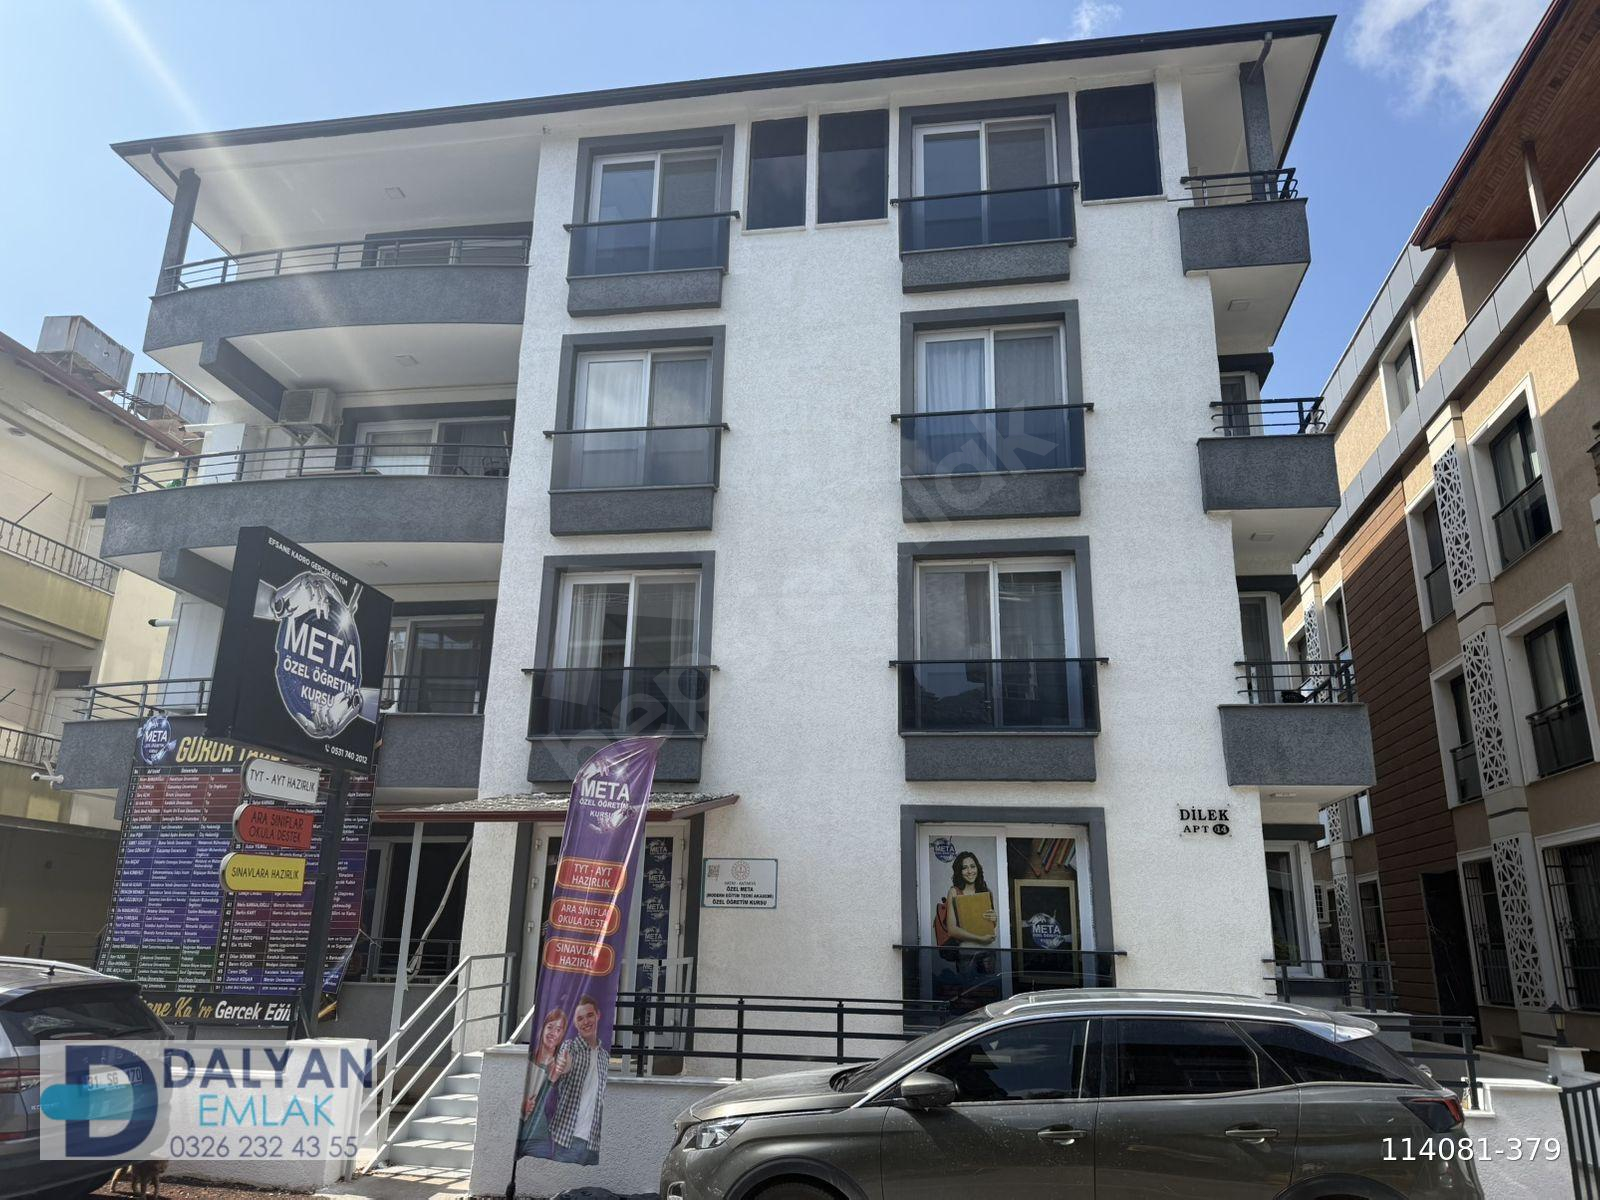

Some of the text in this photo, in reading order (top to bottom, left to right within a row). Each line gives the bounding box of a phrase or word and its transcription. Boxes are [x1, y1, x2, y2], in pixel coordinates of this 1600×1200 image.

[268, 537, 290, 554] EFSANE
[291, 550, 310, 566] KADRO
[283, 616, 357, 678] META
[283, 655, 356, 693] ÖZEL ÖĞRETİM
[301, 685, 335, 707] KURSU
[145, 730, 168, 742] META
[331, 746, 368, 764] 0531 740 2012
[250, 770, 264, 782] TYT
[271, 774, 286, 786] AYT
[287, 777, 315, 792] HAZIRLIK
[581, 779, 630, 801] META
[579, 798, 596, 806] ÖZEL
[1180, 806, 1229, 821] DİLEK
[251, 812, 304, 830] ARA SINIFLAR
[249, 826, 274, 840] OKULA
[232, 867, 299, 880] SINAVLARA HAZIRLIK
[574, 864, 588, 873] TYT
[595, 866, 612, 876] AYT
[572, 875, 610, 888] HAZIRLIK
[561, 904, 608, 916] ARA SINIFLA
[558, 915, 605, 928] OKULA DEST
[1032, 924, 1061, 934] META
[556, 943, 598, 957] SINAVLA
[560, 956, 593, 969] HAZIRLI
